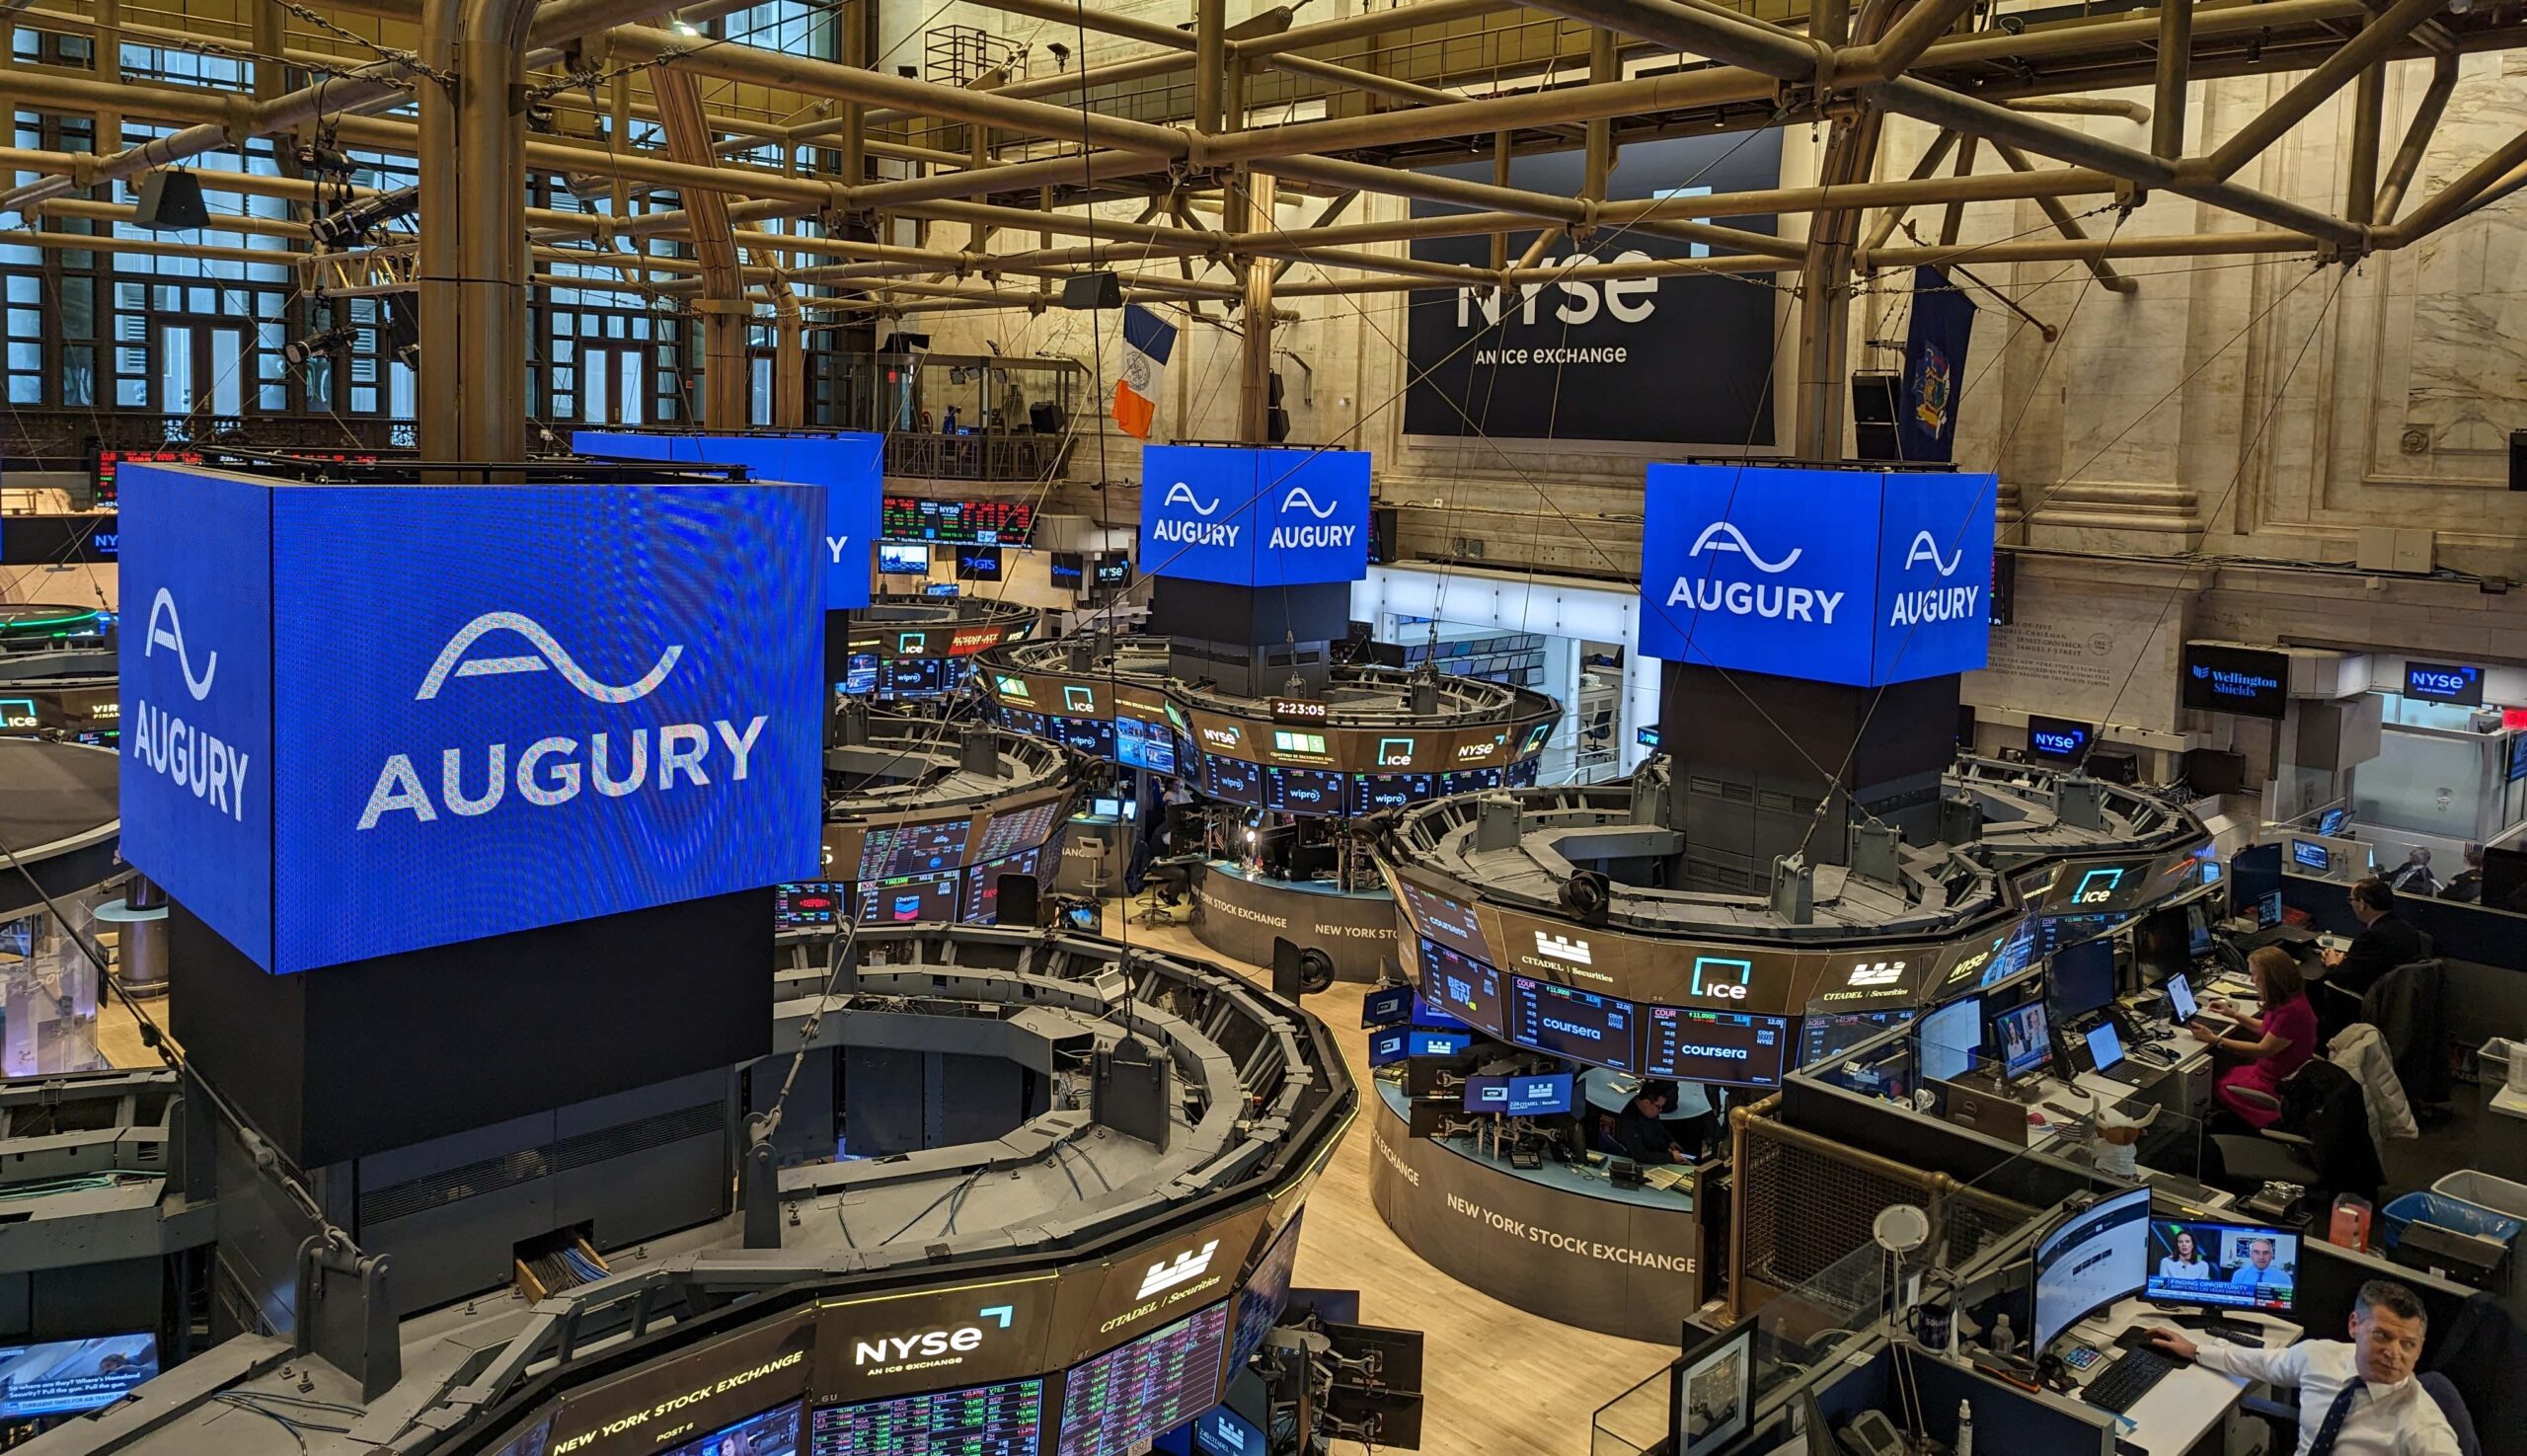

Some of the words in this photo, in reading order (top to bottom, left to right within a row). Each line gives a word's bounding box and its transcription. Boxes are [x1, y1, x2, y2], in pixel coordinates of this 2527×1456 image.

[1475, 348, 1496, 364] AN
[1153, 519, 1240, 547] AUGURY
[1269, 525, 1355, 549] AUGURY
[975, 559, 996, 570] GTS
[1666, 576, 1844, 624] AUGURY
[1890, 585, 1979, 627] AUGURY
[2212, 670, 2277, 688] Wellington
[2214, 682, 2257, 697] Shields
[1277, 703, 1325, 717] 2:23:05
[134, 699, 249, 822] AUGURY
[356, 716, 769, 830] AUGURY
[1221, 776, 1242, 789] wipro
[1290, 790, 1317, 801] wipro
[1376, 795, 1403, 805] wipro
[896, 894, 920, 903] Chevron
[1214, 898, 1237, 915] STOCK
[1238, 907, 1287, 928] EXCHANGE
[1315, 924, 1341, 936] NEW
[1344, 926, 1376, 939] YORK
[1521, 956, 1565, 971] CITADEL
[1571, 966, 1613, 983] Securities
[1447, 975, 1472, 994] BEST
[1516, 978, 1535, 989] COUR
[1450, 989, 1471, 1005] BUY
[1823, 991, 1863, 1001] CITADEL
[1871, 988, 1909, 998] Securities
[1543, 1018, 1601, 1040] coursera
[1682, 1044, 1747, 1059] coursera
[1380, 1138, 1419, 1188] EXCHANGE
[1447, 1192, 1480, 1219] NEW
[1483, 1208, 1525, 1238] YORK
[1529, 1226, 1588, 1256] STOCK
[1592, 1243, 1696, 1273] EXCHANGE
[2200, 1281, 2249, 1291] OPPORTUNITY
[1101, 1303, 1158, 1334] CITADEL
[1169, 1274, 1221, 1305] Securities
[868, 1366, 883, 1376] AN
[55, 1379, 75, 1388] they?
[76, 1375, 104, 1384] Where's
[105, 1372, 140, 1382] Homeland
[9, 1390, 41, 1400] Security?
[111, 1381, 126, 1390] gun.
[22, 1400, 53, 1409] TURBULENT
[553, 1429, 597, 1456] NEW
[601, 1410, 651, 1437] YORK
[653, 1386, 713, 1418] STOCK
[716, 1350, 804, 1394] EXCHANGE
[655, 1426, 686, 1443] POST
[688, 1422, 694, 1431] 6
